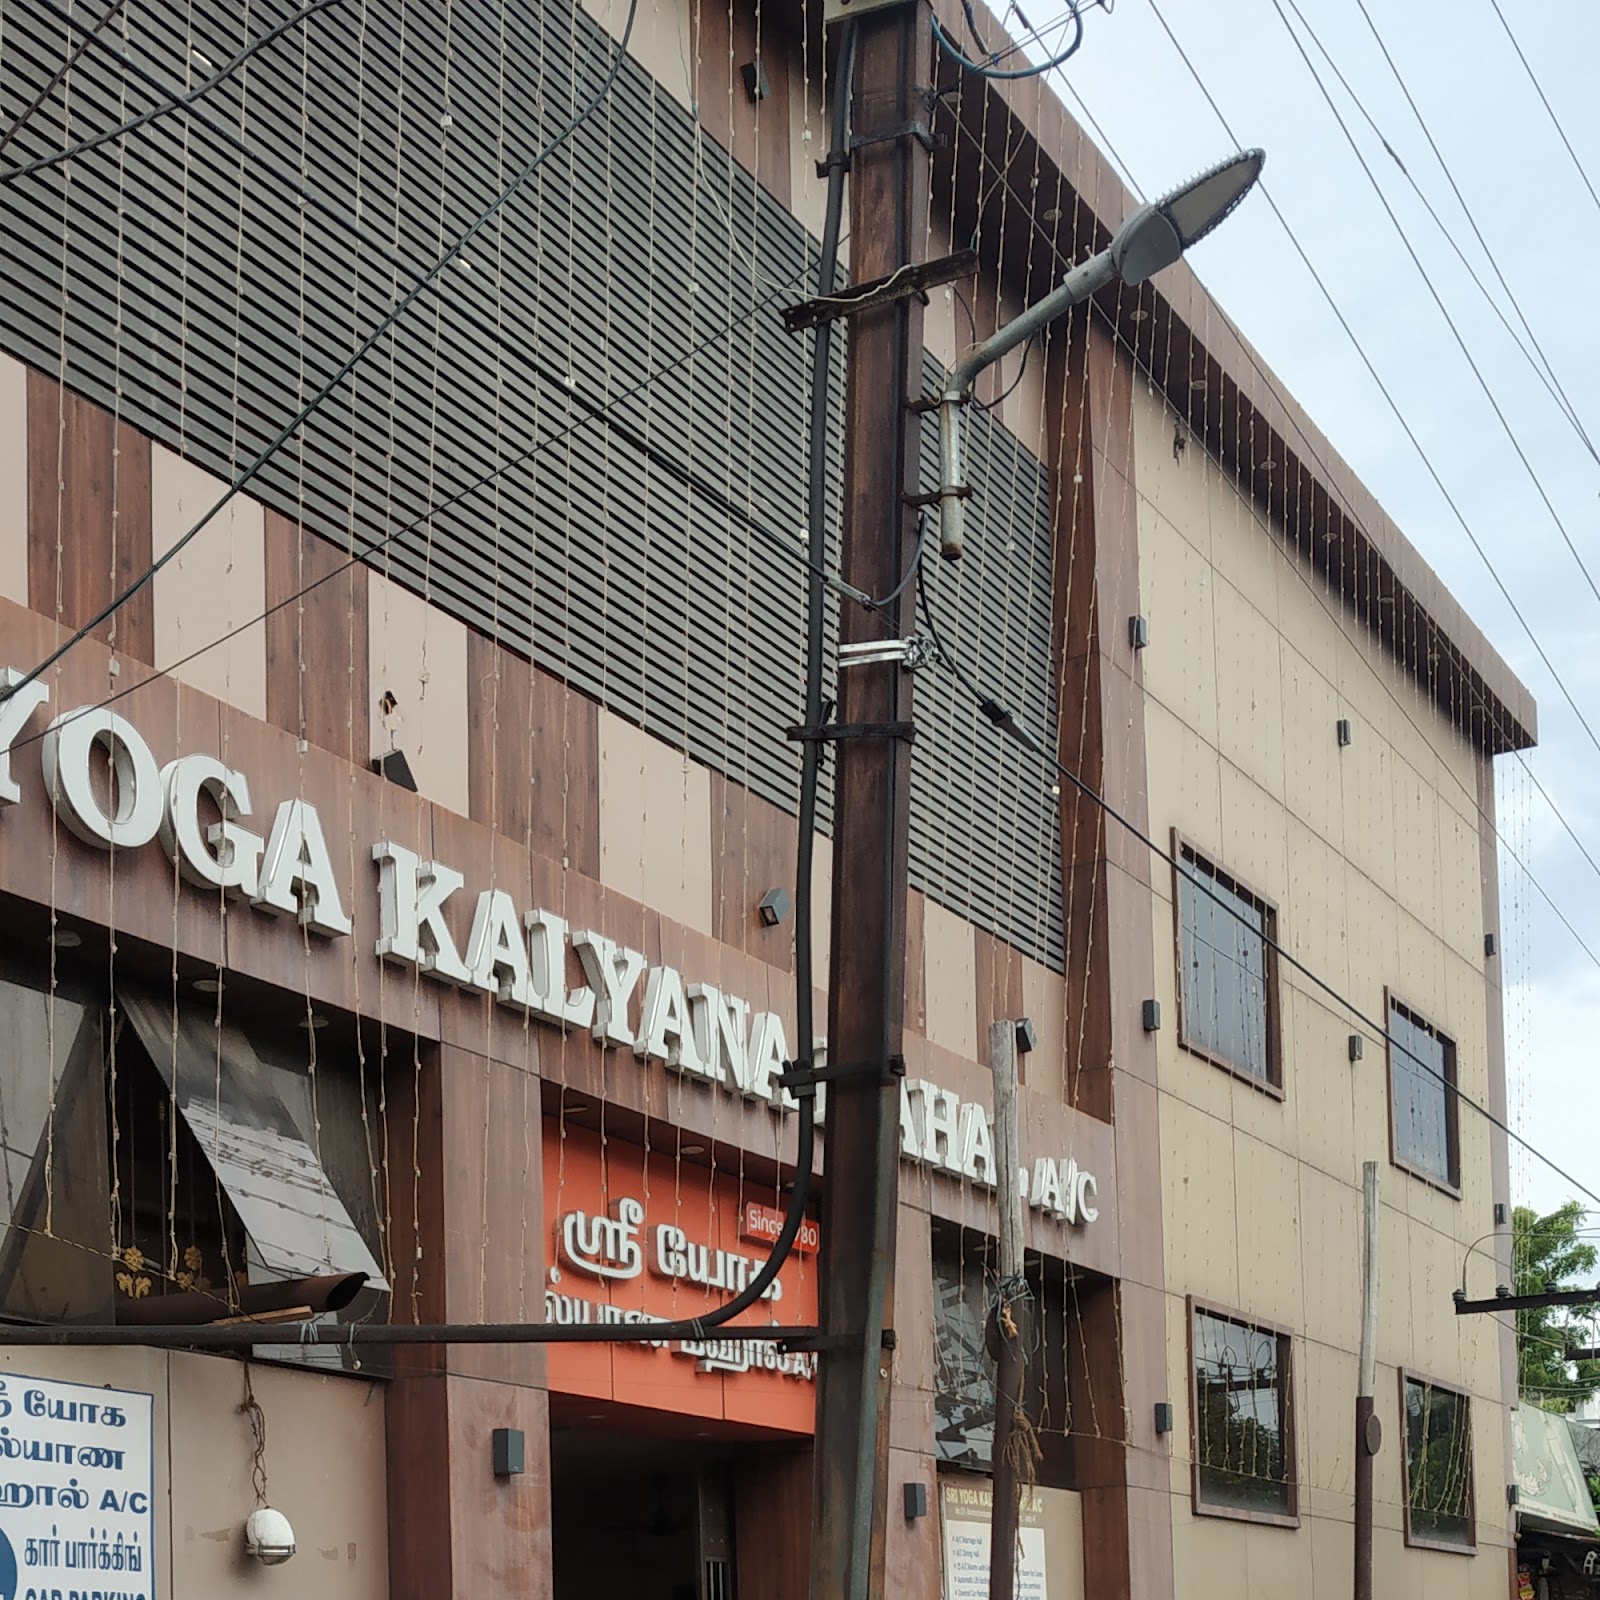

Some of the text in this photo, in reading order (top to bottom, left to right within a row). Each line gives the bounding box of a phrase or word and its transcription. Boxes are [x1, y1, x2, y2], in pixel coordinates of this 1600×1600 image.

[373, 841, 800, 1113] KALYANA
[1030, 1156, 1099, 1225] A/C
[24, 1389, 127, 1427] யோக
[99, 1489, 149, 1514] A/C
[946, 1487, 958, 1504] SRI
[959, 1488, 979, 1507] YOGA
[24, 1524, 142, 1572] கார் பார்க்கிங்
